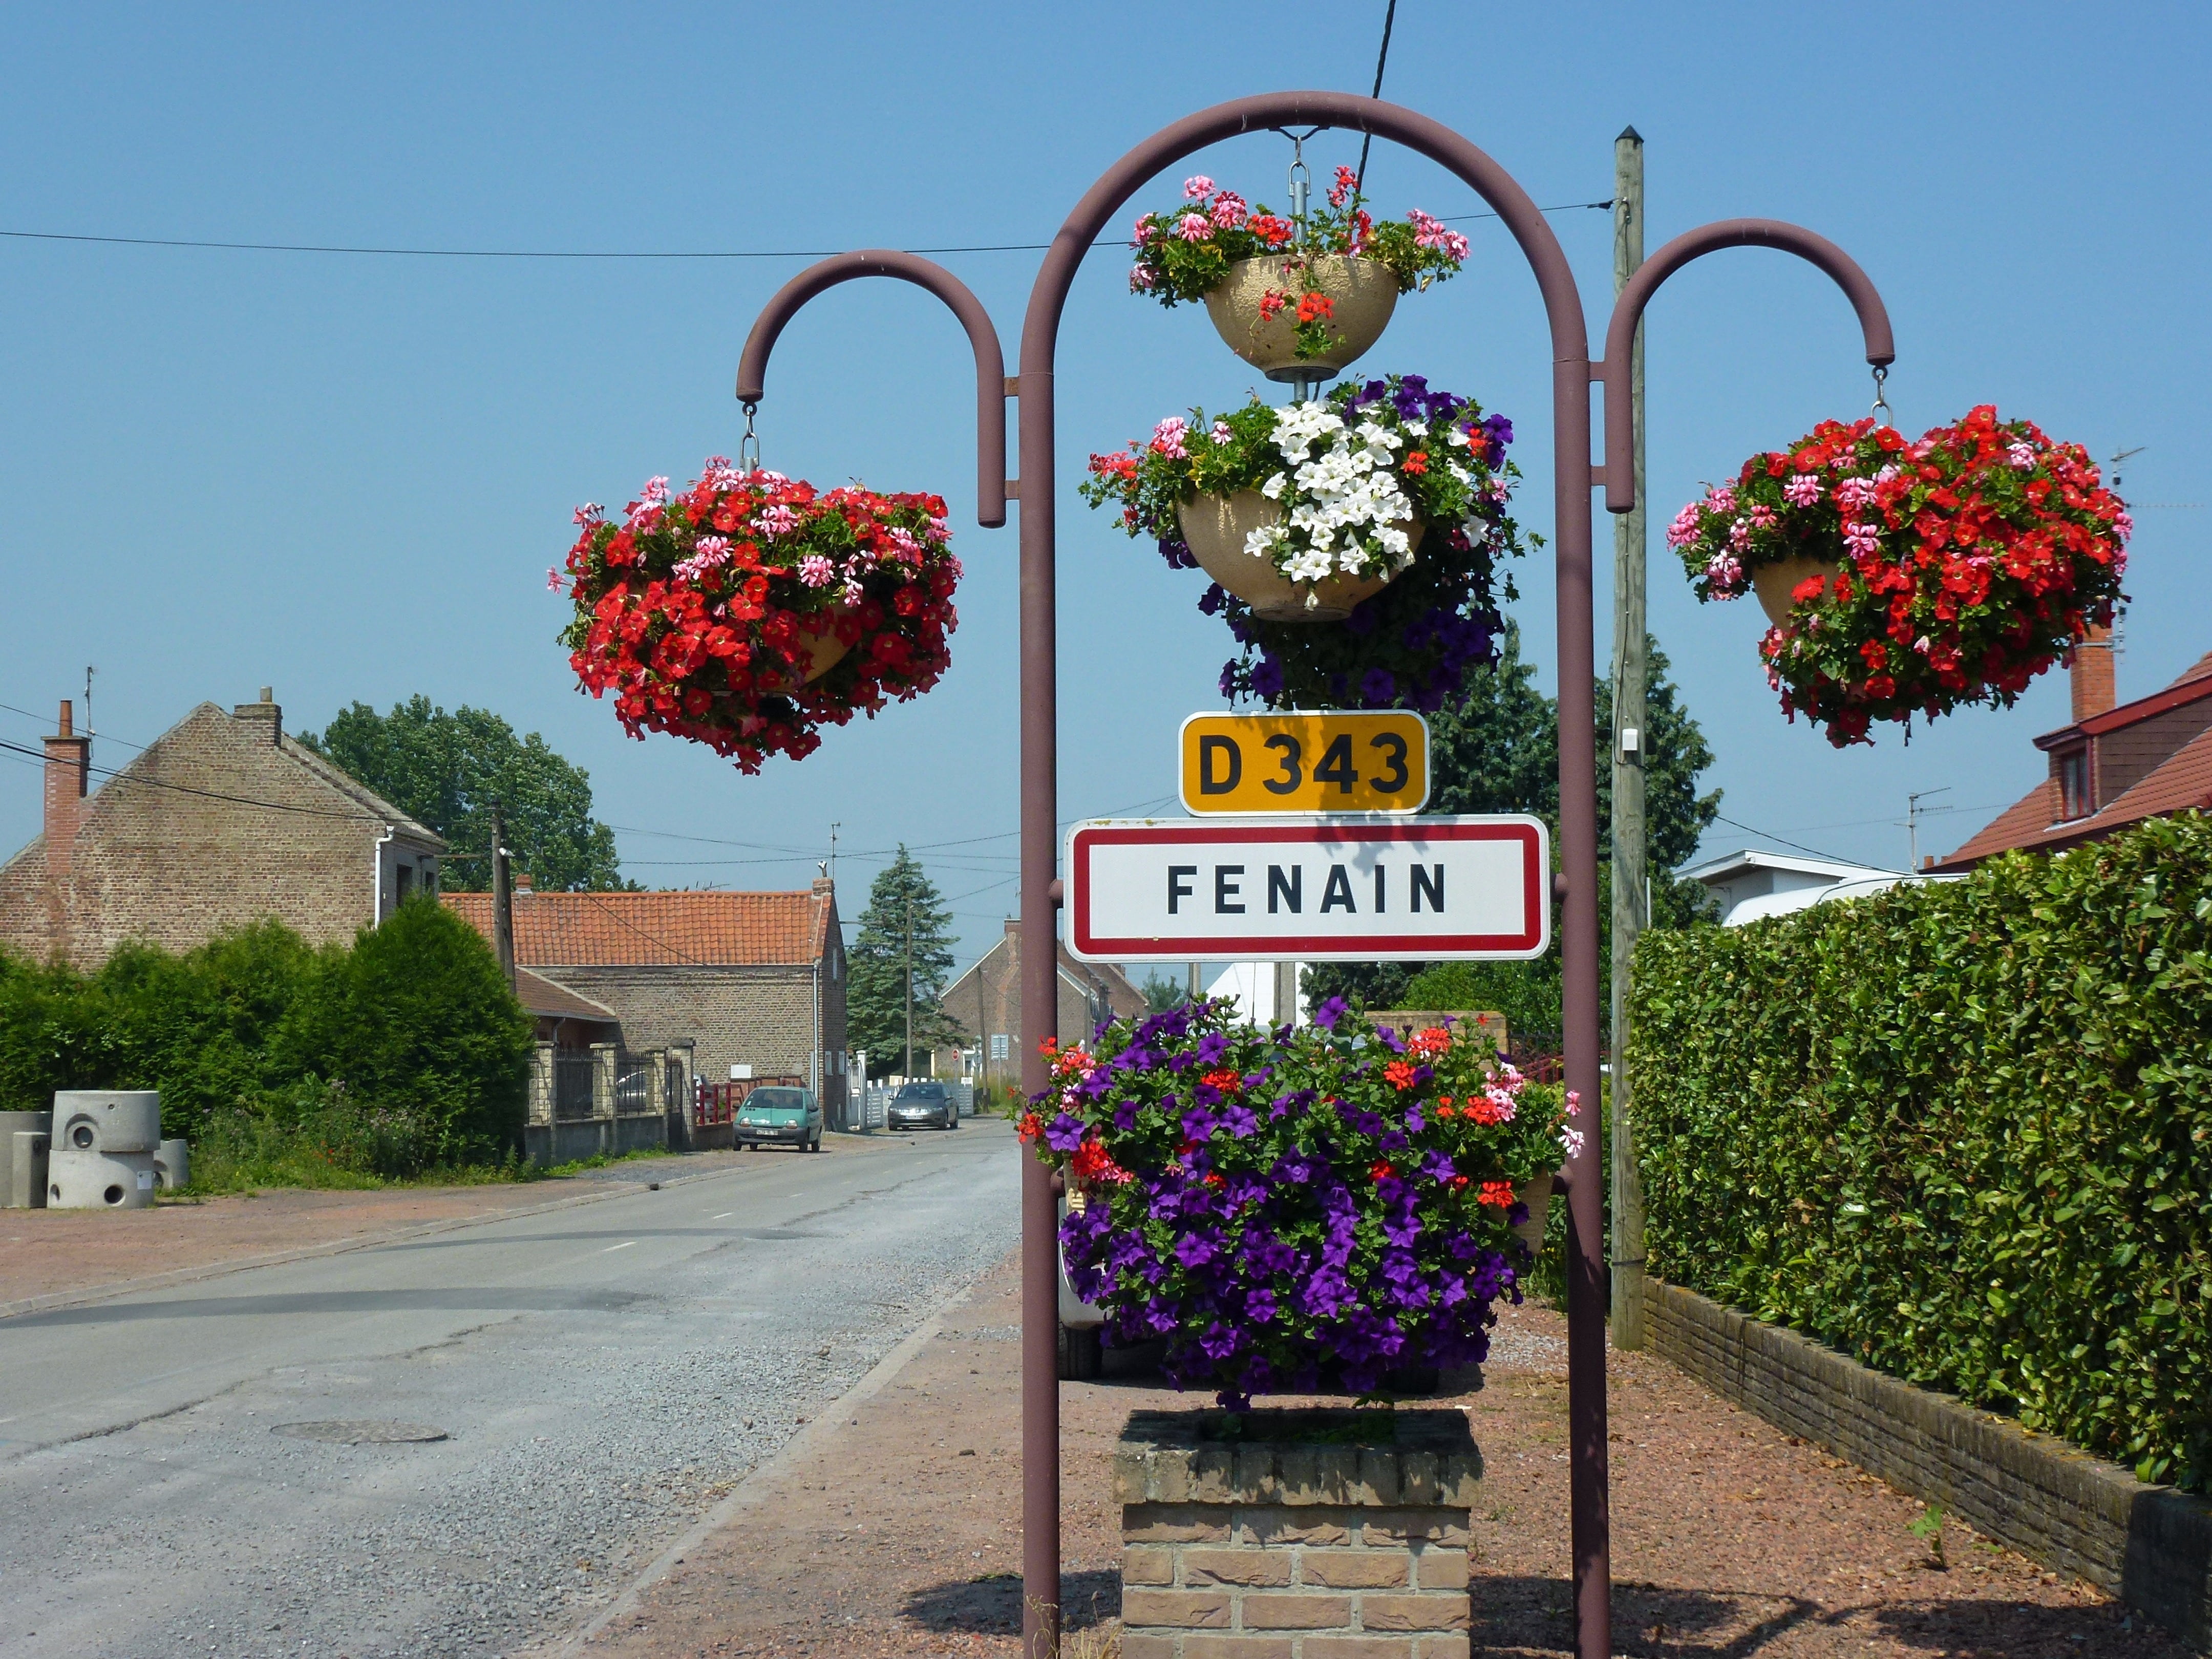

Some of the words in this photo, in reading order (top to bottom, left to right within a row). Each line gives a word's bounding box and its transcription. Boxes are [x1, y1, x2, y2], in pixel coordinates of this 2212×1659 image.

[1200, 735, 1242, 795] D
[1263, 732, 1409, 795] 343
[1168, 864, 1444, 914] FENAIN
